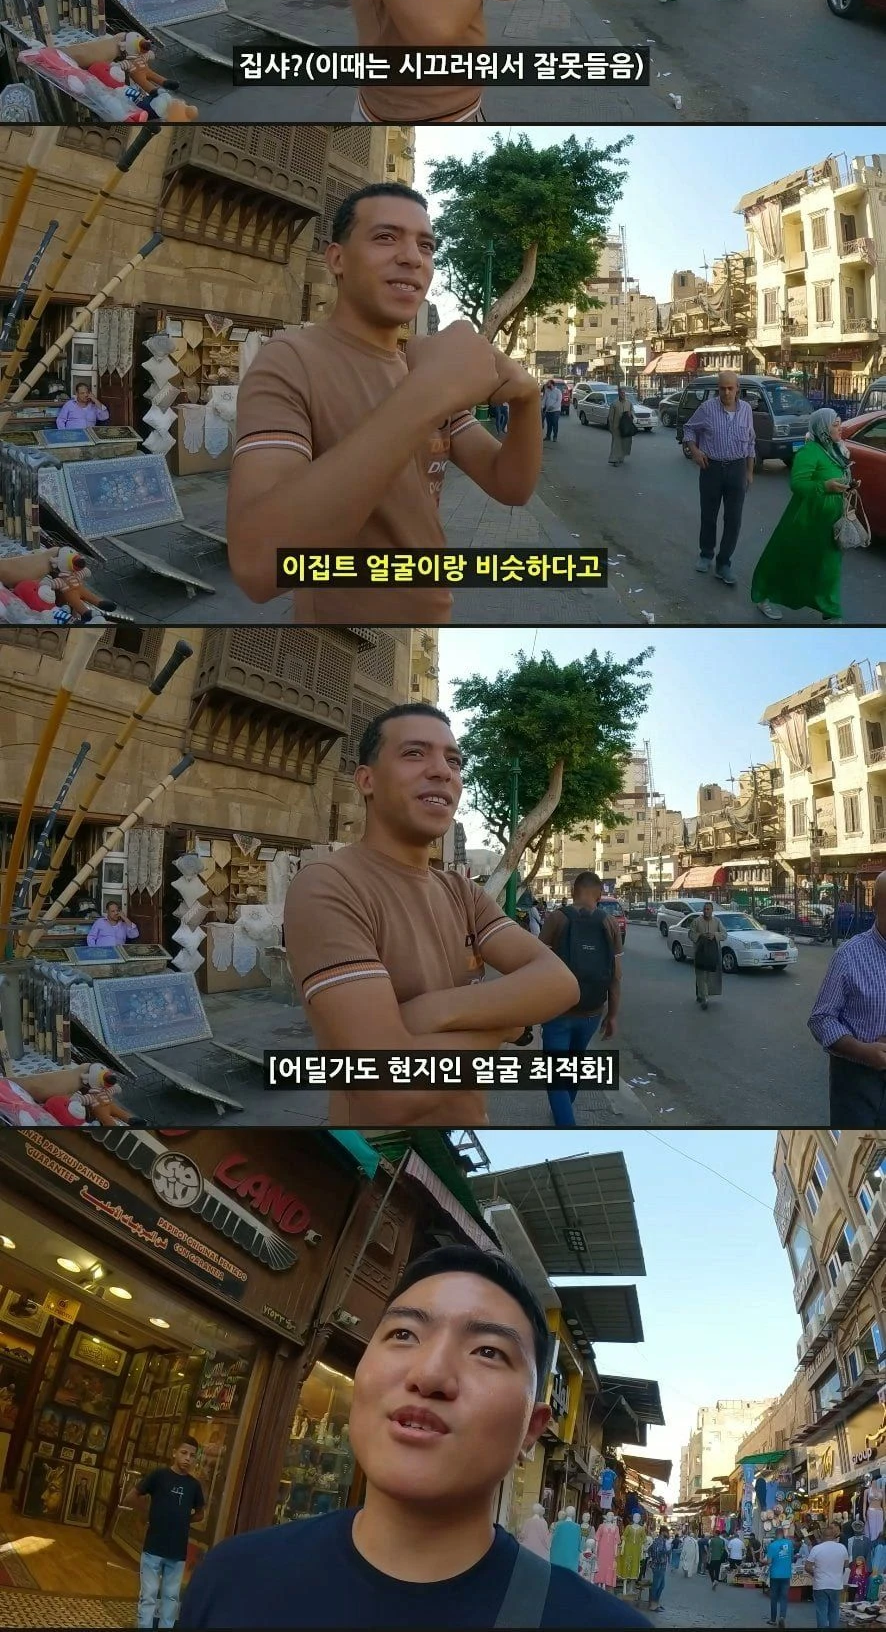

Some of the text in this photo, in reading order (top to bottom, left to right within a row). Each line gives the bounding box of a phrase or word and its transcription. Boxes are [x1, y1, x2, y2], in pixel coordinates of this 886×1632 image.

[41, 1139, 79, 1168] PAPYRUS
[75, 1162, 110, 1190] PAINTED
[213, 1152, 310, 1234] LAND
[173, 1243, 190, 1259] CON
[186, 1236, 221, 1264] ORIGINAL
